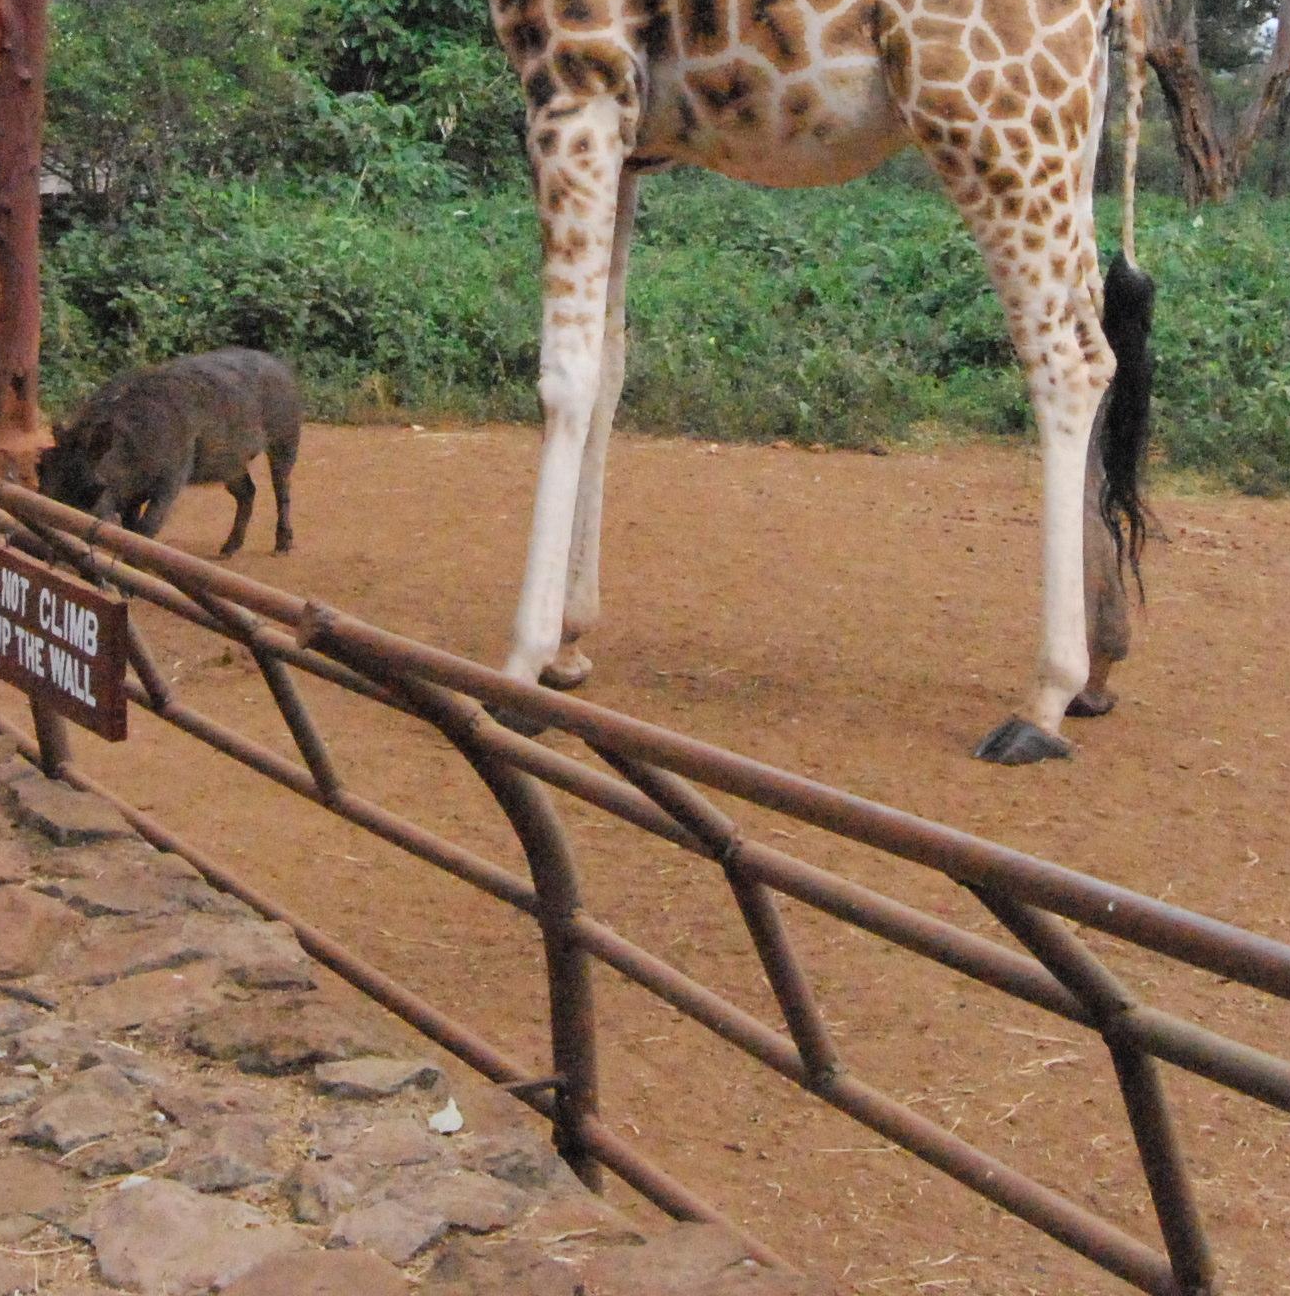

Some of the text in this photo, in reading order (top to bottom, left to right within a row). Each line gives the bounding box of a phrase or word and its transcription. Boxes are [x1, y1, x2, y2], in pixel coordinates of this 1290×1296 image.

[1, 567, 30, 617] NOT
[39, 587, 99, 657] CLIMB
[14, 625, 45, 677] THE
[49, 643, 97, 708] WALL
